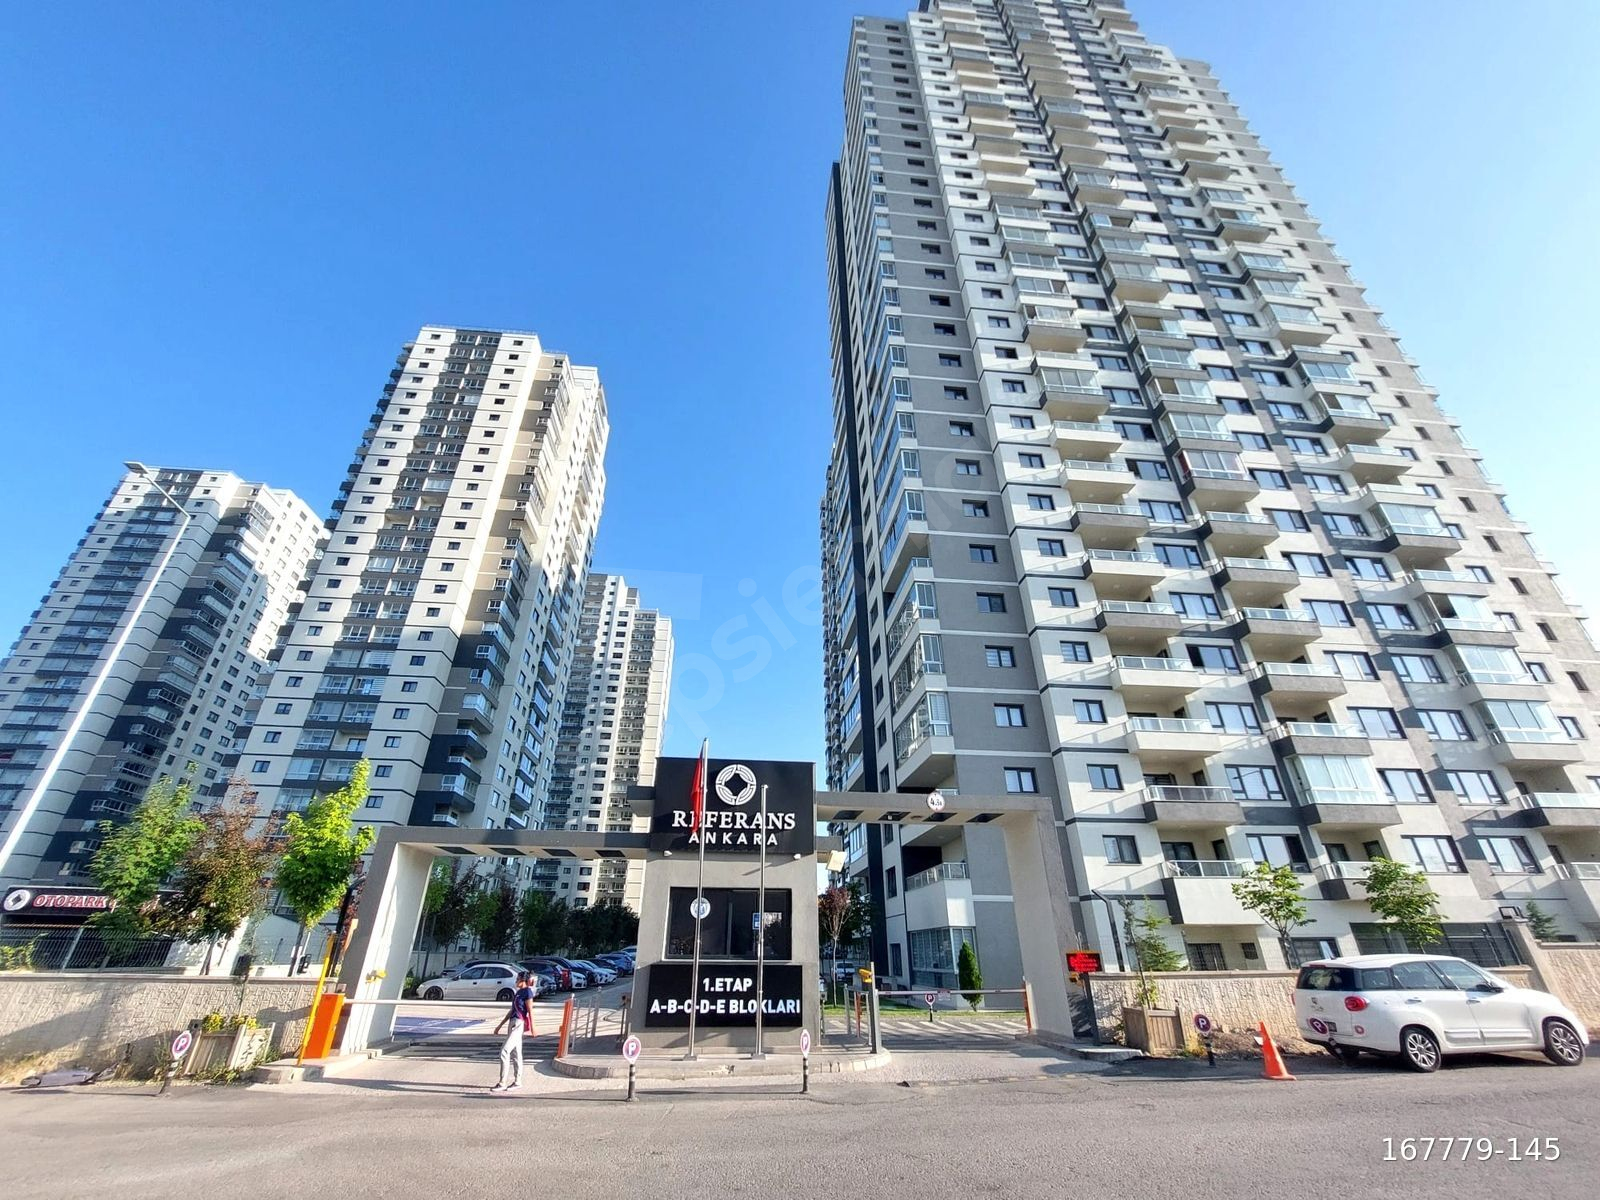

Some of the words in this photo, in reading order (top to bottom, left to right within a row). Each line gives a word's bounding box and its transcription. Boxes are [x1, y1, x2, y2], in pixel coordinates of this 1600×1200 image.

[688, 831, 778, 845] ANKARA
[33, 895, 107, 909] OTOPARK
[702, 978, 753, 992] 1.ETAP
[650, 999, 725, 1014] A-B-C-D-E
[729, 999, 800, 1014] BLOKLARI
[1199, 1018, 1206, 1028] P
[177, 1038, 187, 1051] P
[628, 1042, 637, 1056] P
